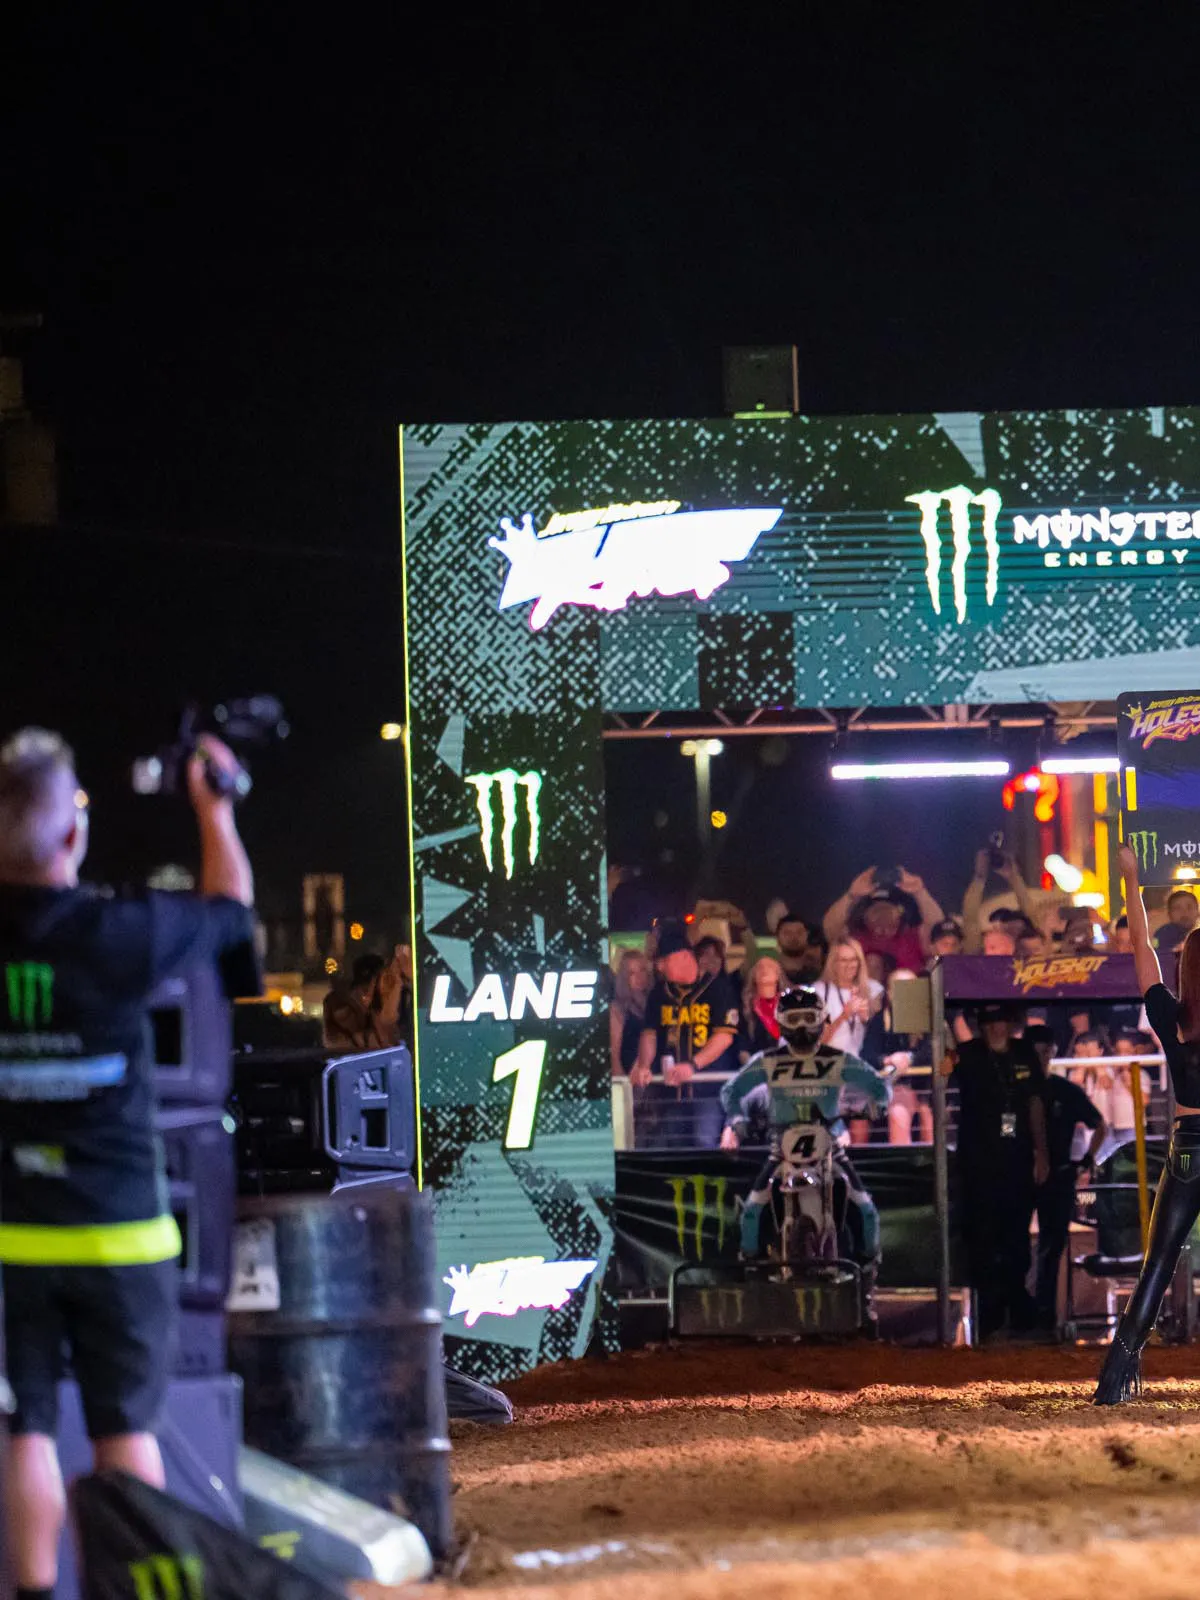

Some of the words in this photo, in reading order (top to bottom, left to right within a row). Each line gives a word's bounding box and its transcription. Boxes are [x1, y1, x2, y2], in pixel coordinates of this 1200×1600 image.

[1044, 549, 1188, 568] ENERGY
[429, 970, 598, 1023] LANE
[693, 1024, 709, 1047] 3
[771, 1060, 836, 1081] FLY
[492, 1039, 547, 1149] 1
[791, 1134, 816, 1158] 4
